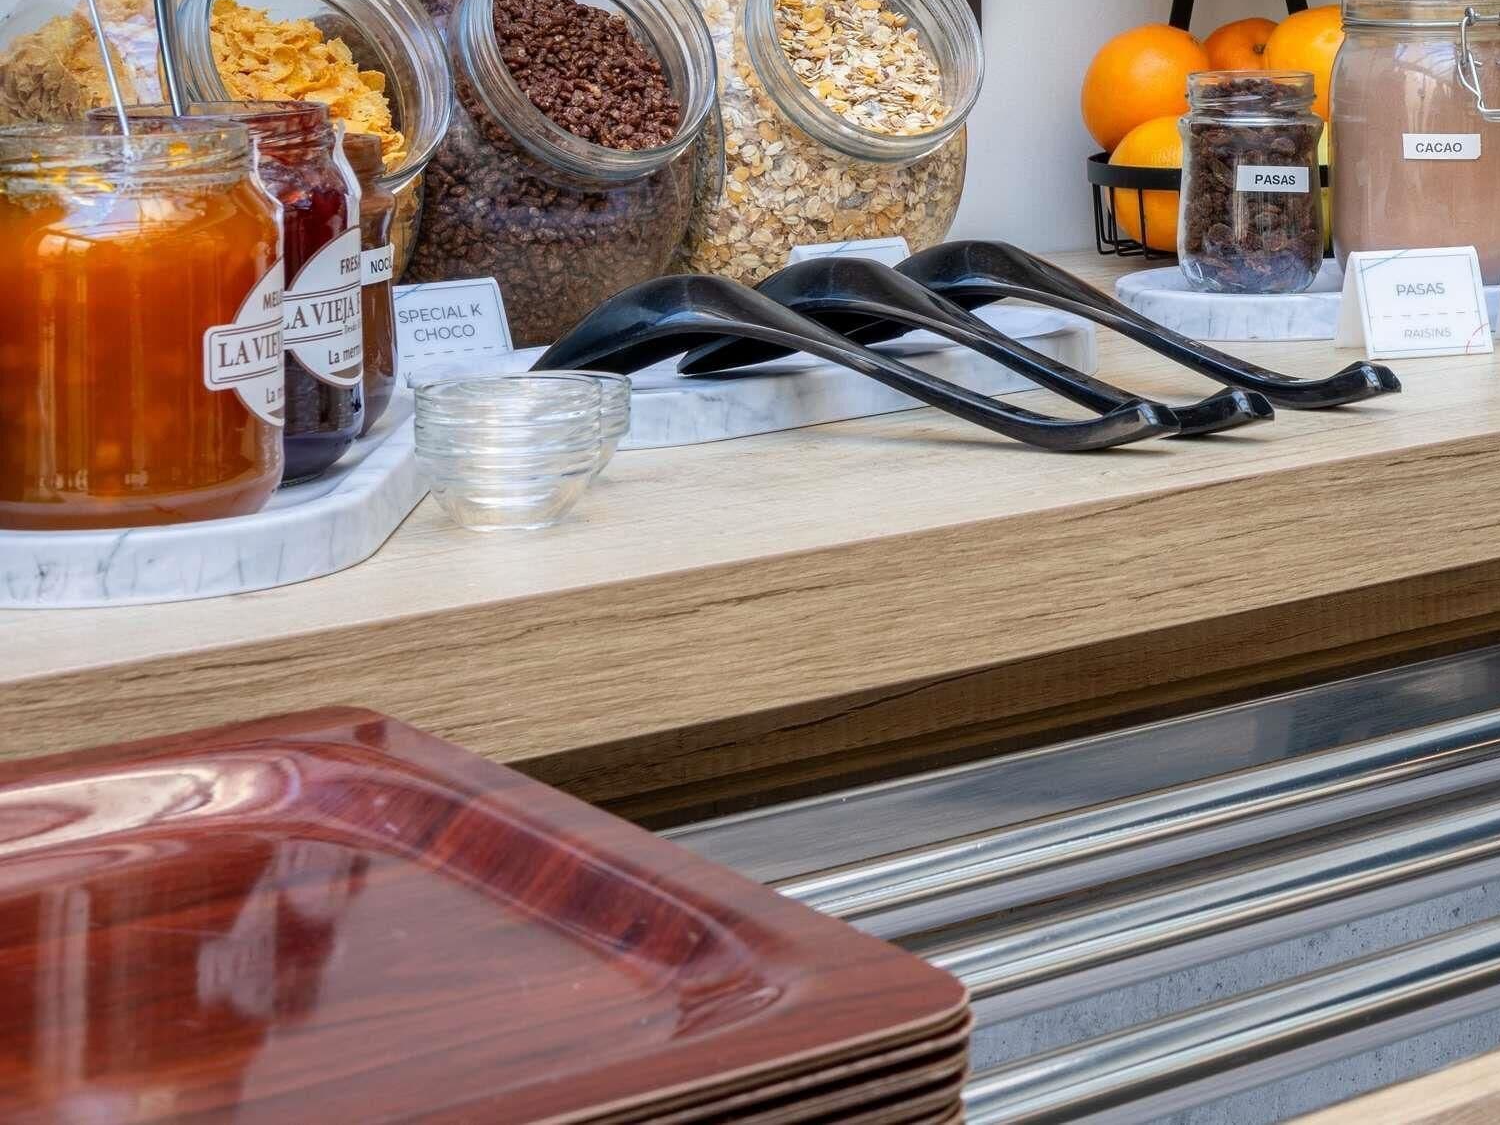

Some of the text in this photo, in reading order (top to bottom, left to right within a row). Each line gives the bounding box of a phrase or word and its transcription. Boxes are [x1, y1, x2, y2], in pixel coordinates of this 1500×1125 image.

[1415, 142, 1462, 153] CACAO
[1255, 174, 1296, 185] PASAS
[1396, 282, 1446, 296] PASAS
[311, 296, 355, 326] VIEJA
[399, 303, 483, 324] SPECIAL K
[414, 324, 476, 342] CHOCO
[1404, 325, 1453, 339] RAISINS
[218, 340, 250, 368] LA
[328, 350, 340, 365] La
[265, 387, 276, 404] La
